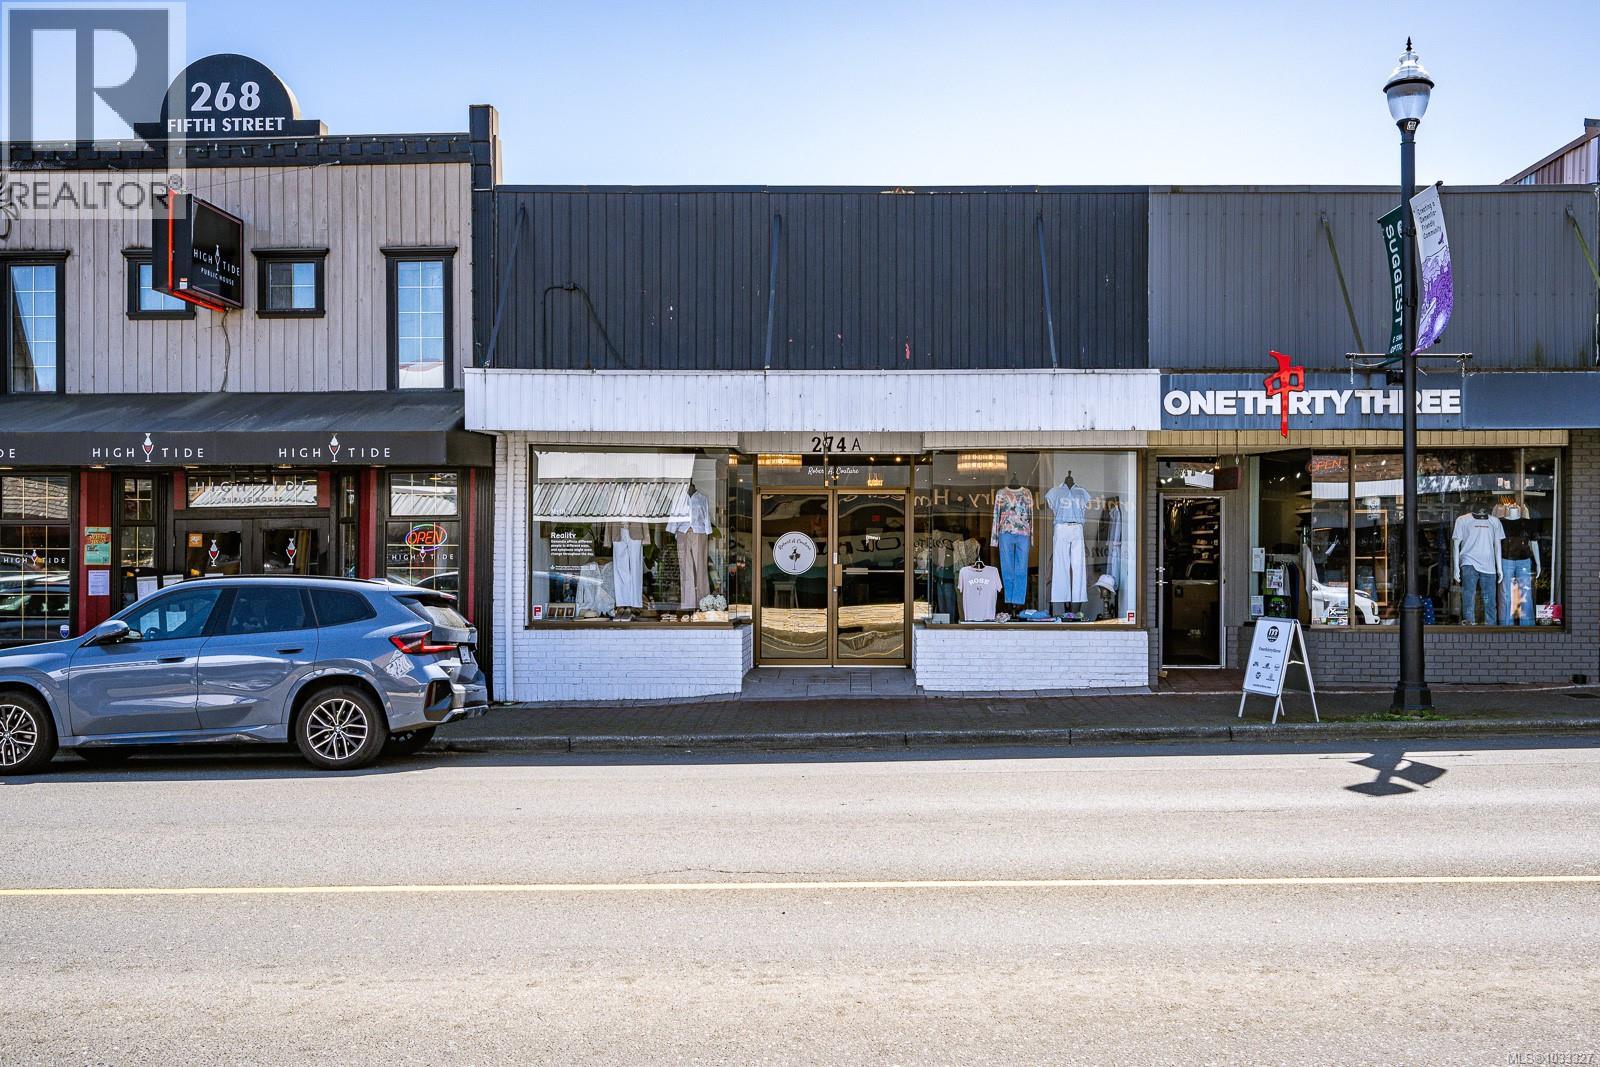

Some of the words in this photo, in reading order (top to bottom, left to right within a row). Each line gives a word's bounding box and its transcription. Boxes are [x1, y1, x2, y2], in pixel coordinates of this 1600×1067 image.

[191, 82, 261, 111] 268
[168, 119, 216, 132] FIFTH
[222, 117, 285, 131] STREET
[193, 248, 213, 264] HIGH
[223, 261, 240, 276] TIDE
[1386, 224, 1403, 326] SUGGEST
[811, 436, 847, 452] 274
[852, 437, 861, 450] A
[92, 448, 135, 458] HIGH
[162, 448, 204, 458] TIDE
[279, 448, 321, 458] HIGH
[348, 448, 391, 458] TIDE
[808, 467, 827, 475] Rober
[407, 531, 444, 545] OPEN
[551, 532, 577, 540] Reality
